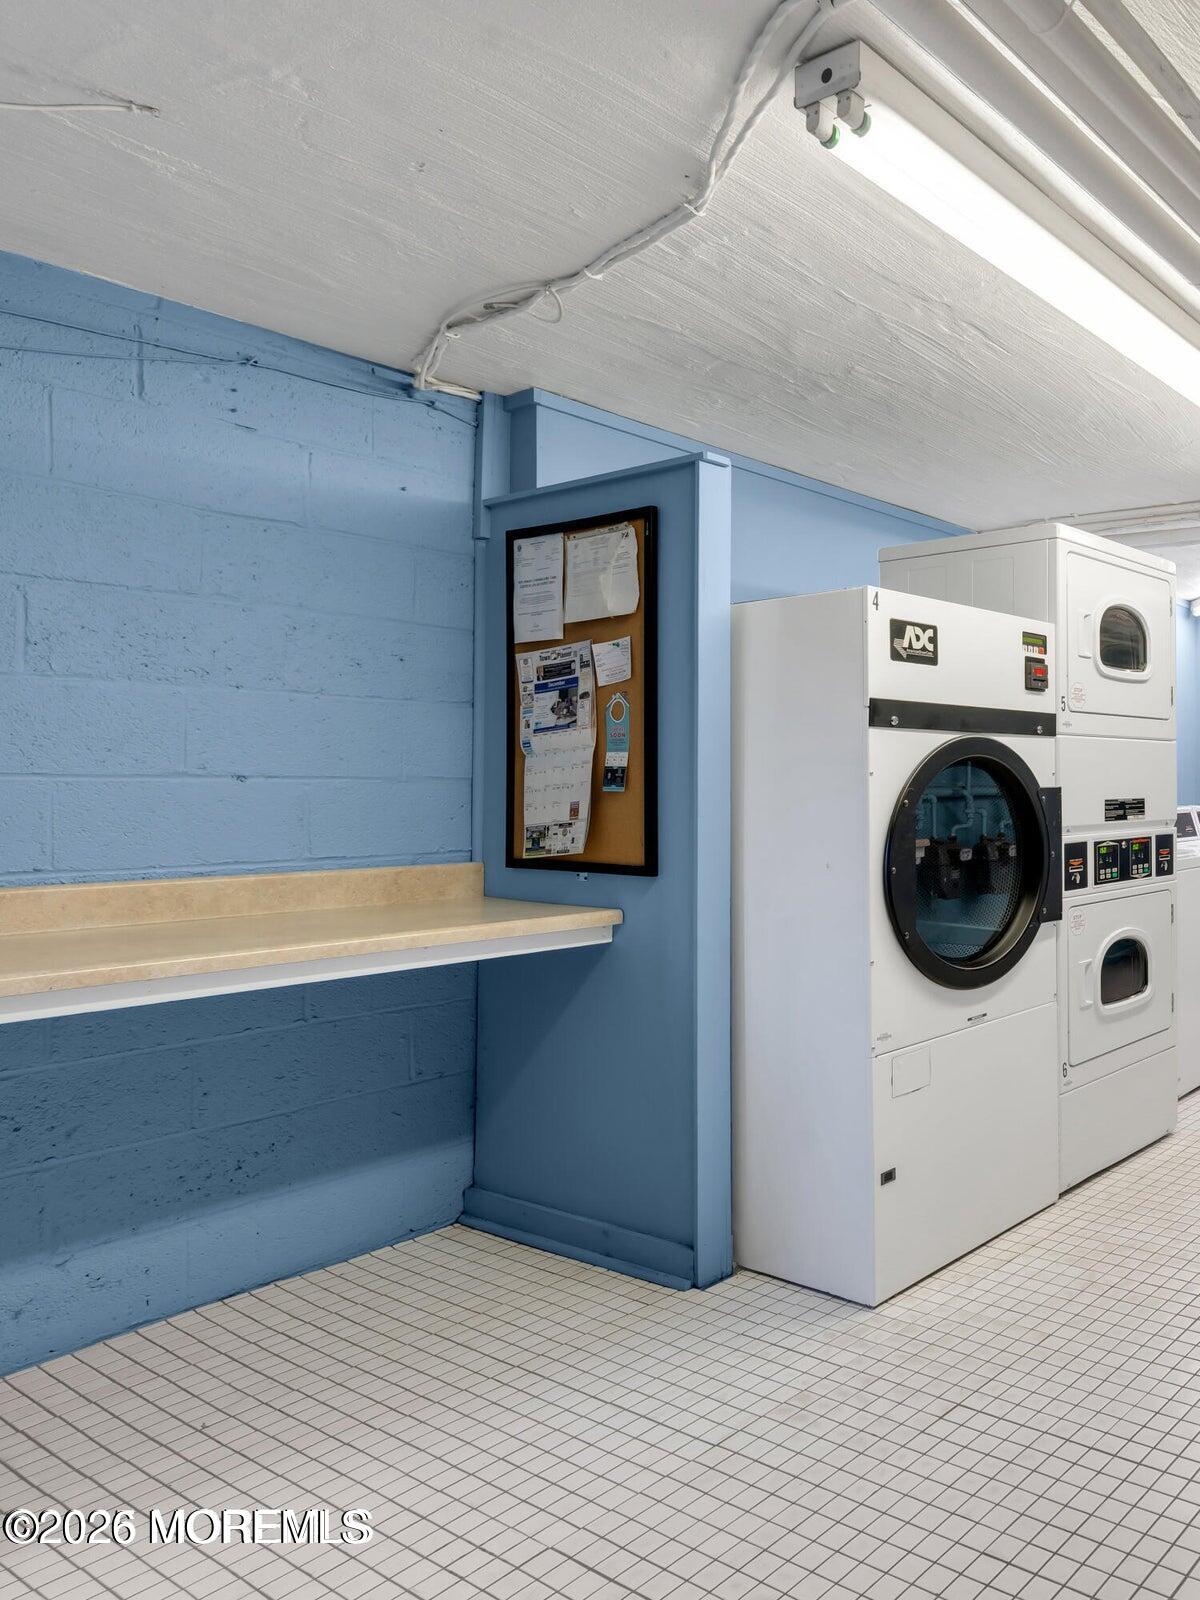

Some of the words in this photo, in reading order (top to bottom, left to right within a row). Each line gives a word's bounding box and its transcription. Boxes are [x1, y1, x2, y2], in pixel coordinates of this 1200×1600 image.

[872, 591, 879, 610] 4
[902, 625, 934, 652] ADC
[1061, 696, 1066, 712] 5
[1062, 1062, 1068, 1078] 6
